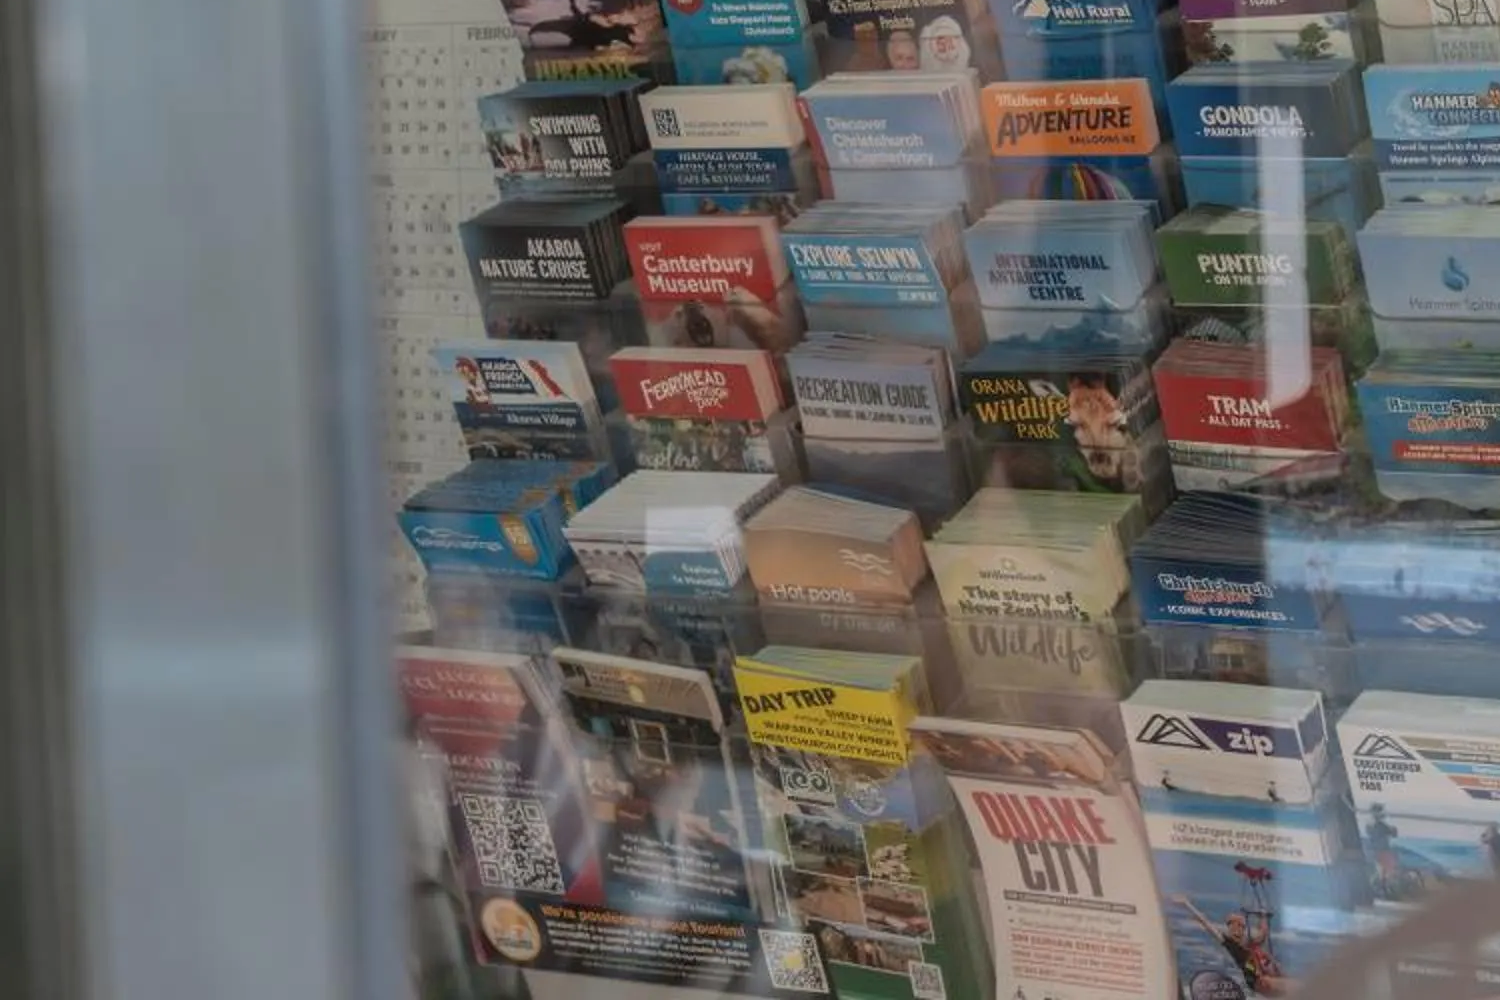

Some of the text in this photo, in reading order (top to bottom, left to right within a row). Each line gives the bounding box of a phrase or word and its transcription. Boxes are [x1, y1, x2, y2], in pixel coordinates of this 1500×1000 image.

[1088, 4, 1132, 18] Rural
[1412, 95, 1478, 111] HANMER
[529, 114, 601, 137] SWIMMING
[825, 116, 887, 132] Discover
[1200, 106, 1303, 128] GONDOLA
[997, 106, 1133, 149] ADVENTURE
[569, 136, 608, 157] WITH
[832, 133, 924, 148] Christchurch
[544, 158, 612, 178] DOLPHINS
[527, 239, 584, 258] AKAROA
[790, 244, 856, 267] EXPLORE
[480, 259, 591, 279] NATURE CRUISE
[643, 255, 753, 275] Canterbury
[995, 253, 1110, 270] INTERNATIONAL
[1198, 254, 1293, 274] PUNTING
[647, 275, 730, 293] Museum
[989, 269, 1067, 286] ANTARCTIC
[1029, 285, 1085, 301] CENTRE
[640, 370, 726, 409] FERRYMEAD
[797, 376, 931, 409] RECREATION GUIDE
[971, 379, 1026, 396] ORANA
[975, 396, 1070, 425] Wildlife
[1207, 395, 1271, 416] TRAM
[1016, 423, 1060, 440] PARK
[1209, 416, 1281, 431] ALL DAY PASS
[770, 584, 856, 604] Hot pools
[962, 586, 1074, 606] The story of
[959, 600, 1091, 622] New Zealand's
[968, 623, 1096, 676] Wildlife
[744, 687, 836, 713] DAY TRIP
[1227, 728, 1273, 759] zip
[971, 790, 1116, 845] QUAKE
[1013, 837, 1104, 897] CITY
